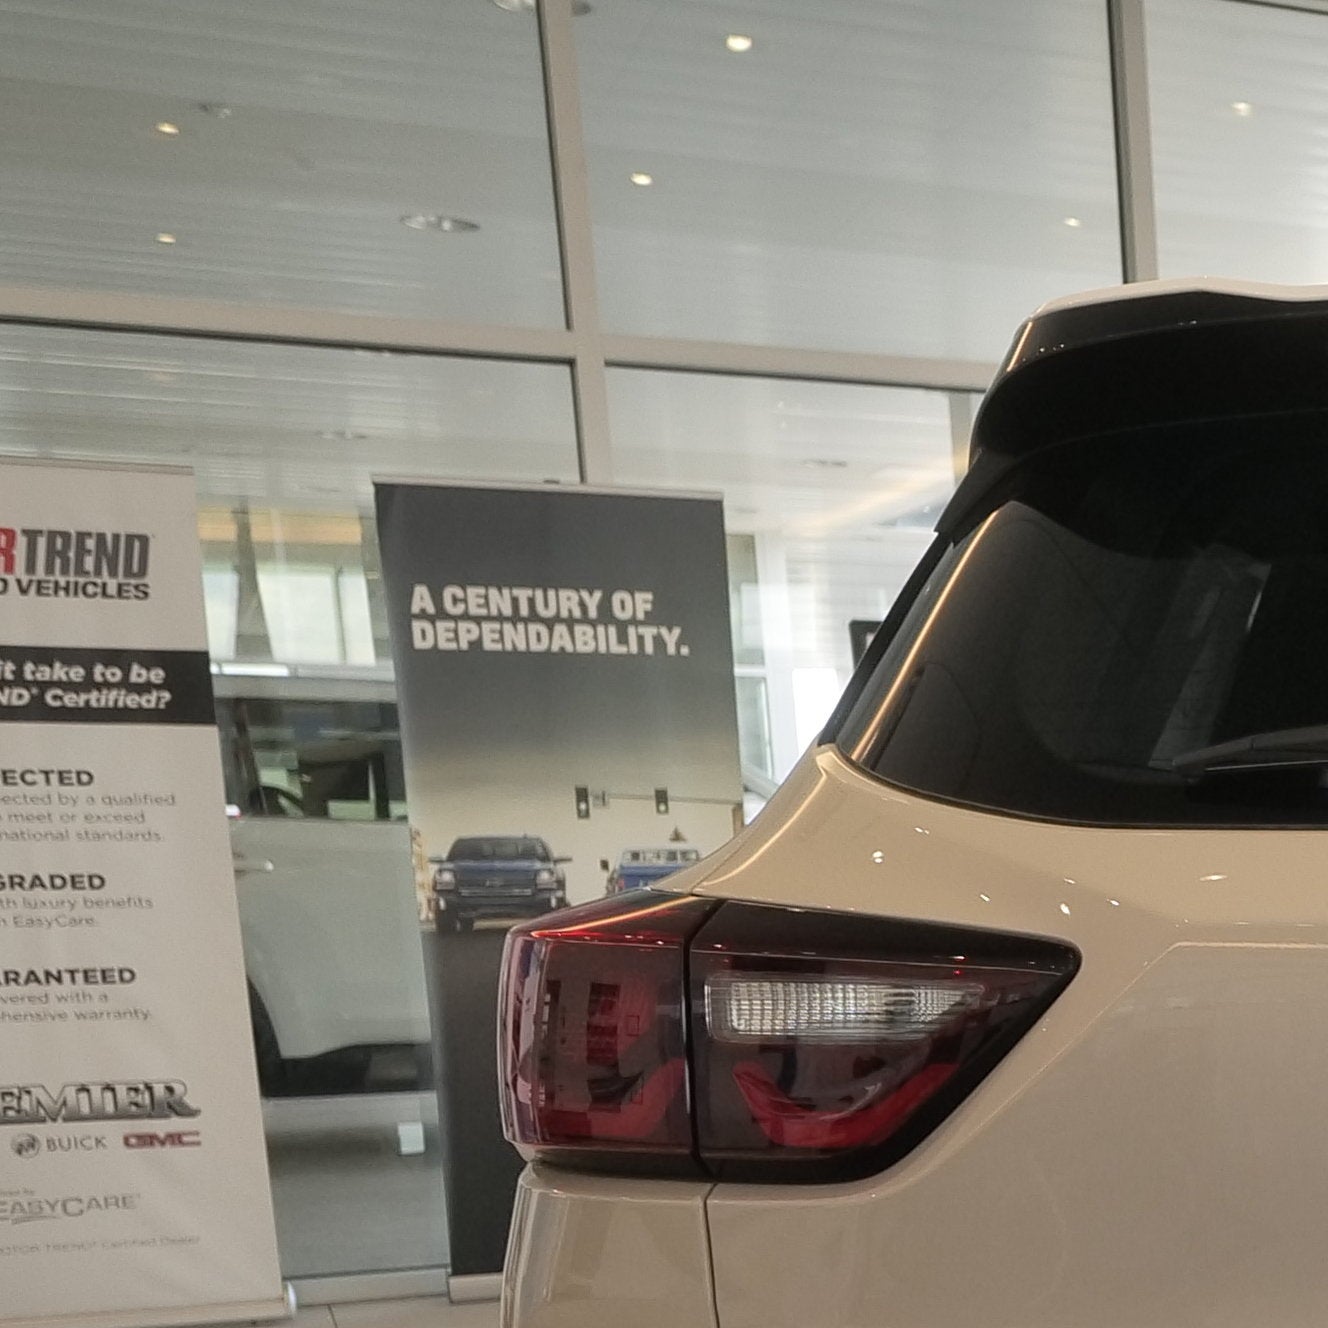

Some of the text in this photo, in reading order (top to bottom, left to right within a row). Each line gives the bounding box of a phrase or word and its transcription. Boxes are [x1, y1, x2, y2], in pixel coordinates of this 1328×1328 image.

[15, 578, 150, 600] VEHICLES
[411, 584, 653, 621] A CENTURY OF
[411, 619, 690, 656] DEPENDABILITY.
[23, 660, 86, 682] take
[93, 662, 123, 683] to
[129, 662, 166, 685] be
[45, 687, 172, 709] Certified?
[1, 769, 94, 787] ECTED
[46, 1131, 201, 1152] BUICK GMC
